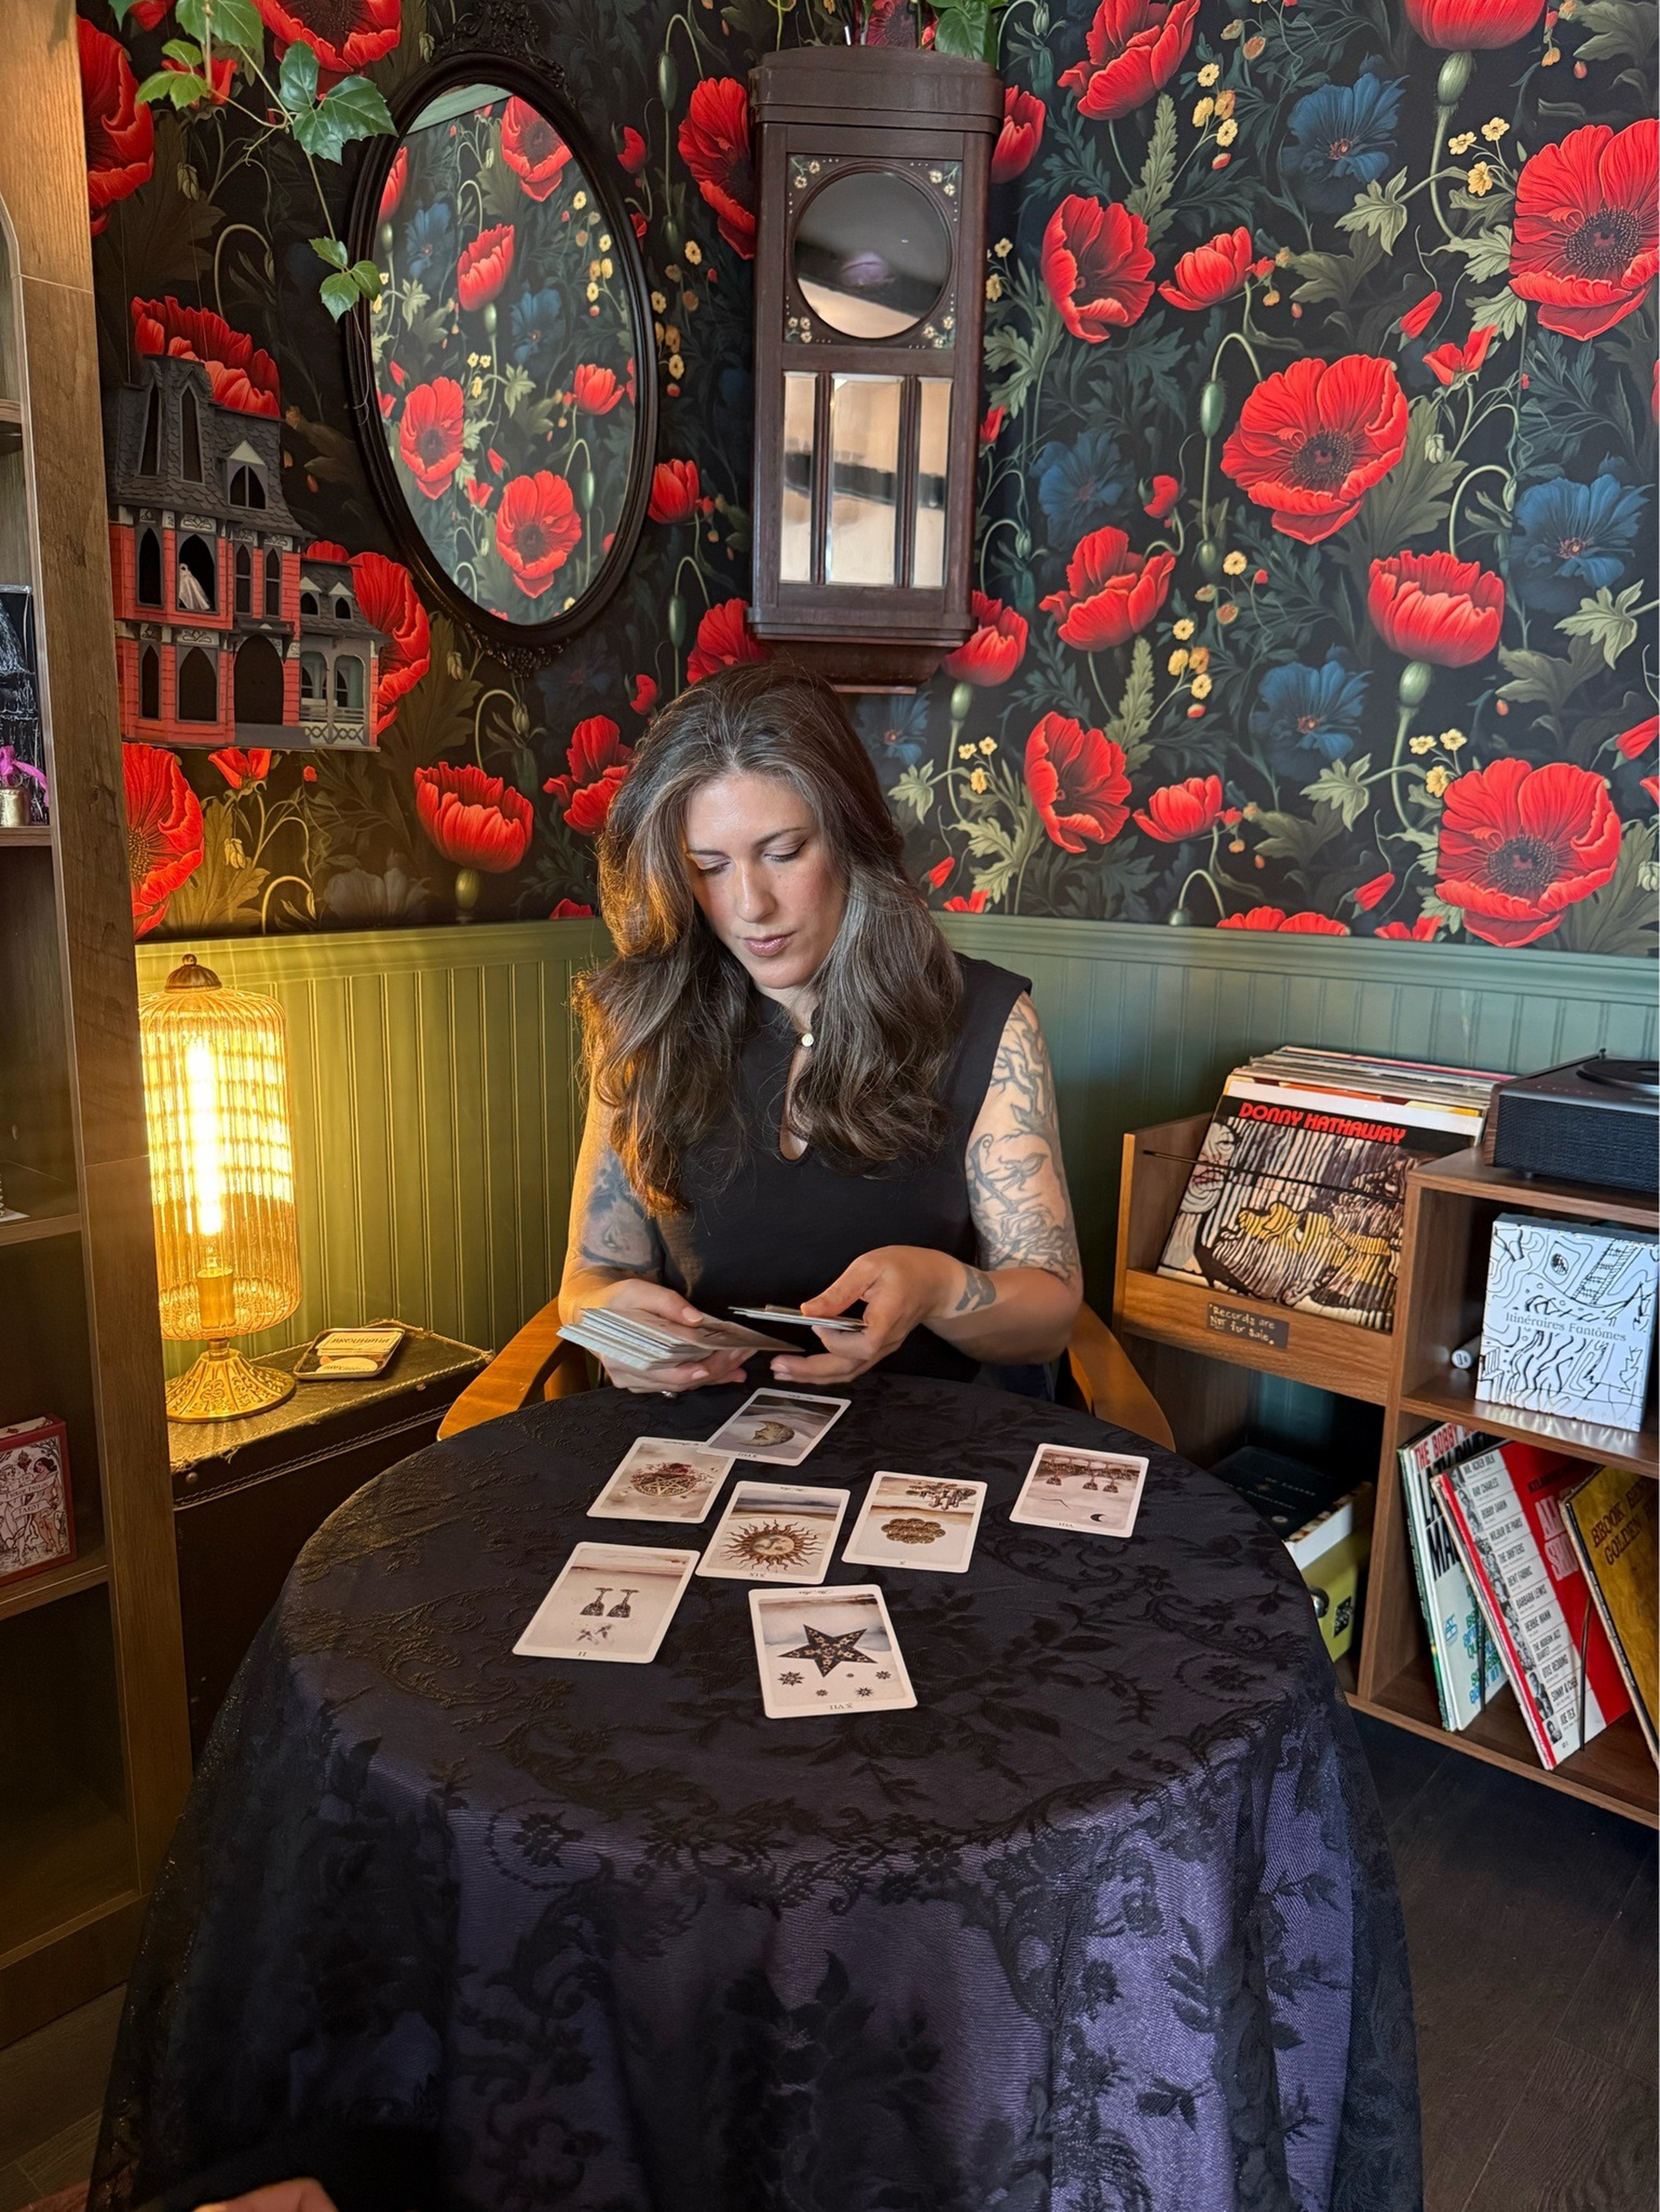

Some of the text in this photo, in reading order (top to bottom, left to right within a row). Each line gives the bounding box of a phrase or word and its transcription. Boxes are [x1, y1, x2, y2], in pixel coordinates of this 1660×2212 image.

[1239, 1103, 1406, 1144] DONNY HATHAWAY
[1258, 1319, 1275, 1329] are
[1505, 1312, 1627, 1342] Itinéraires Fantômes
[1415, 1441, 1431, 1470] THE
[1432, 1424, 1457, 1458] BOBBY
[1480, 1477, 1499, 1493] CHARLES
[1481, 1505, 1494, 1519] BOBBY
[1504, 1523, 1511, 1534] DE
[1591, 1501, 1626, 1549] BROOK
[1604, 1514, 1642, 1565] GOLDEN
[1498, 1552, 1507, 1563] THE
[1506, 1543, 1525, 1559] DRIFTERS
[1516, 1591, 1535, 1609] BARBARA
[1534, 1584, 1547, 1599] LEWIS
[1540, 1635, 1553, 1648] MODERN
[1536, 1646, 1550, 1661] QUARTET
[1542, 1664, 1553, 1679] OTIS
[1551, 1654, 1569, 1672] REDDING
[1551, 1686, 1563, 1702] SONNY
[1564, 1683, 1569, 1694] &
[1567, 1677, 1578, 1691] CHER
[1560, 1713, 1569, 1726] JOE
[1567, 1707, 1576, 1720] TEX
